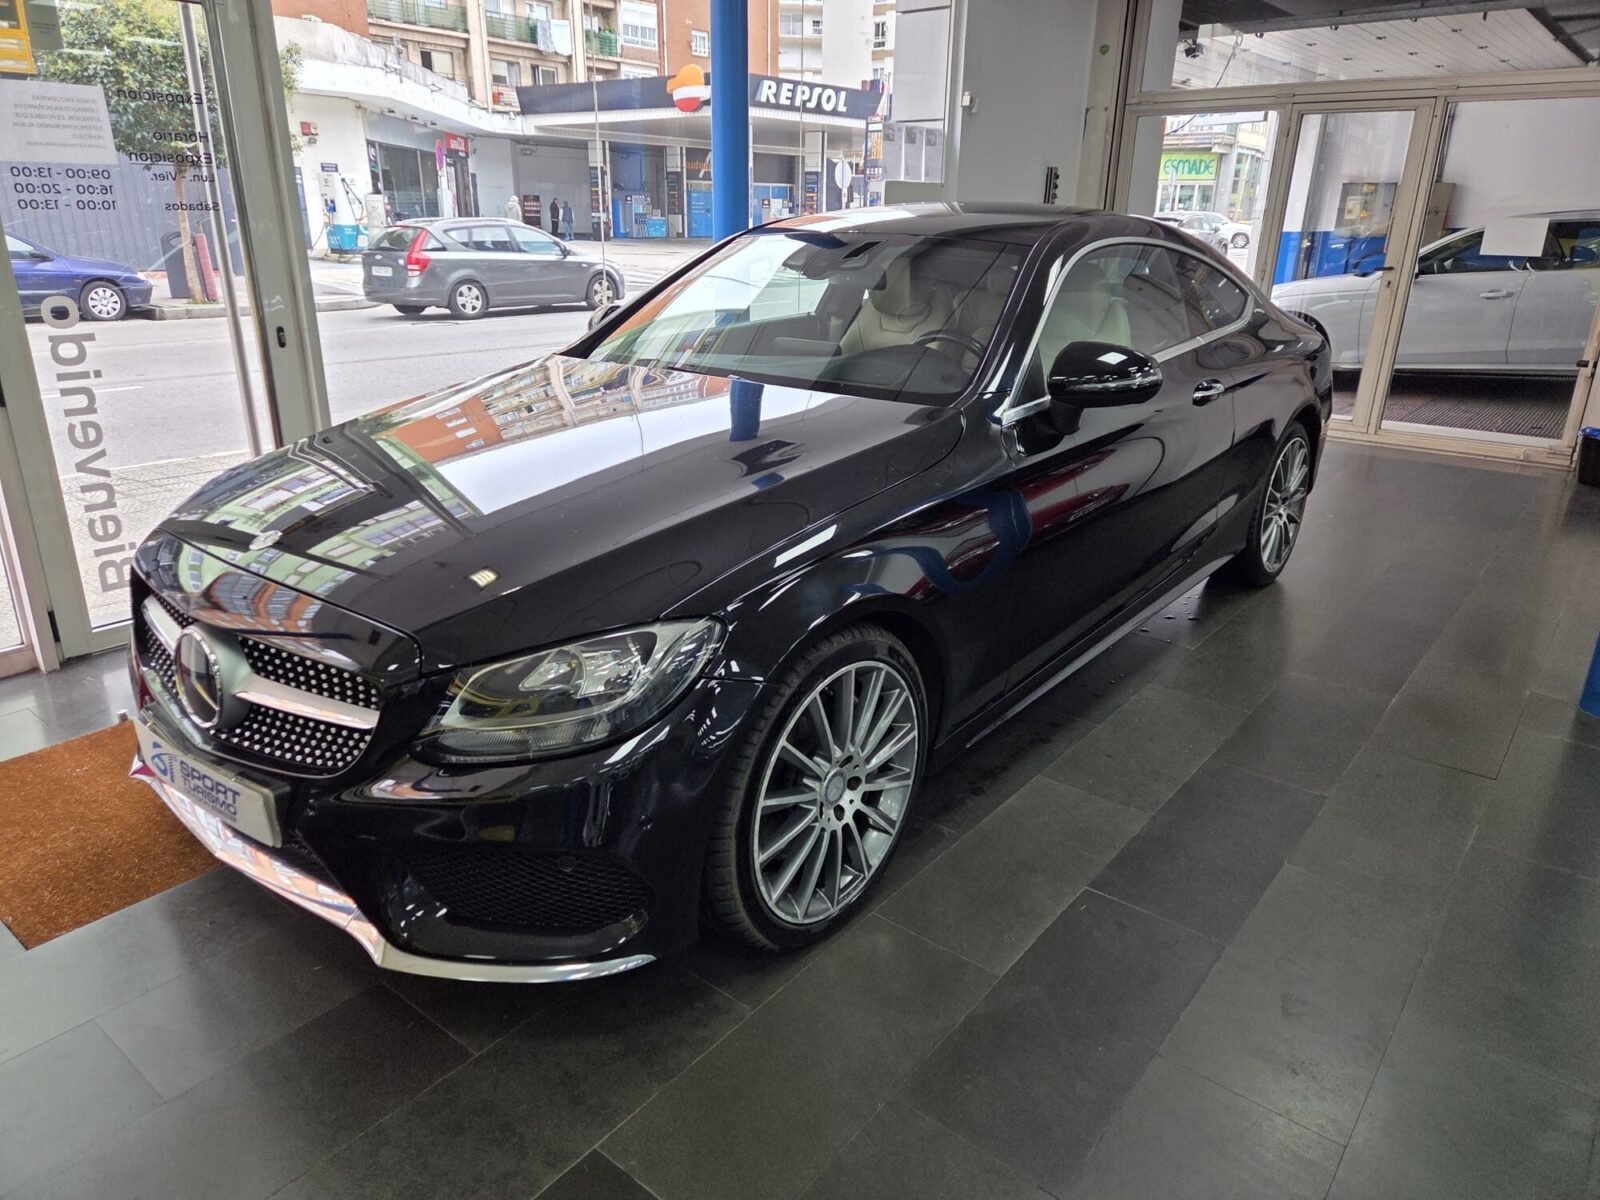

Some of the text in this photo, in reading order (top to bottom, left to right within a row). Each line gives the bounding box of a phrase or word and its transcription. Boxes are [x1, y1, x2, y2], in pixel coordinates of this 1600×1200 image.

[757, 79, 848, 113] REPSOL
[1163, 158, 1216, 175] ESMADE
[179, 760, 241, 805] SPORT
[182, 777, 237, 816] TURISMO
